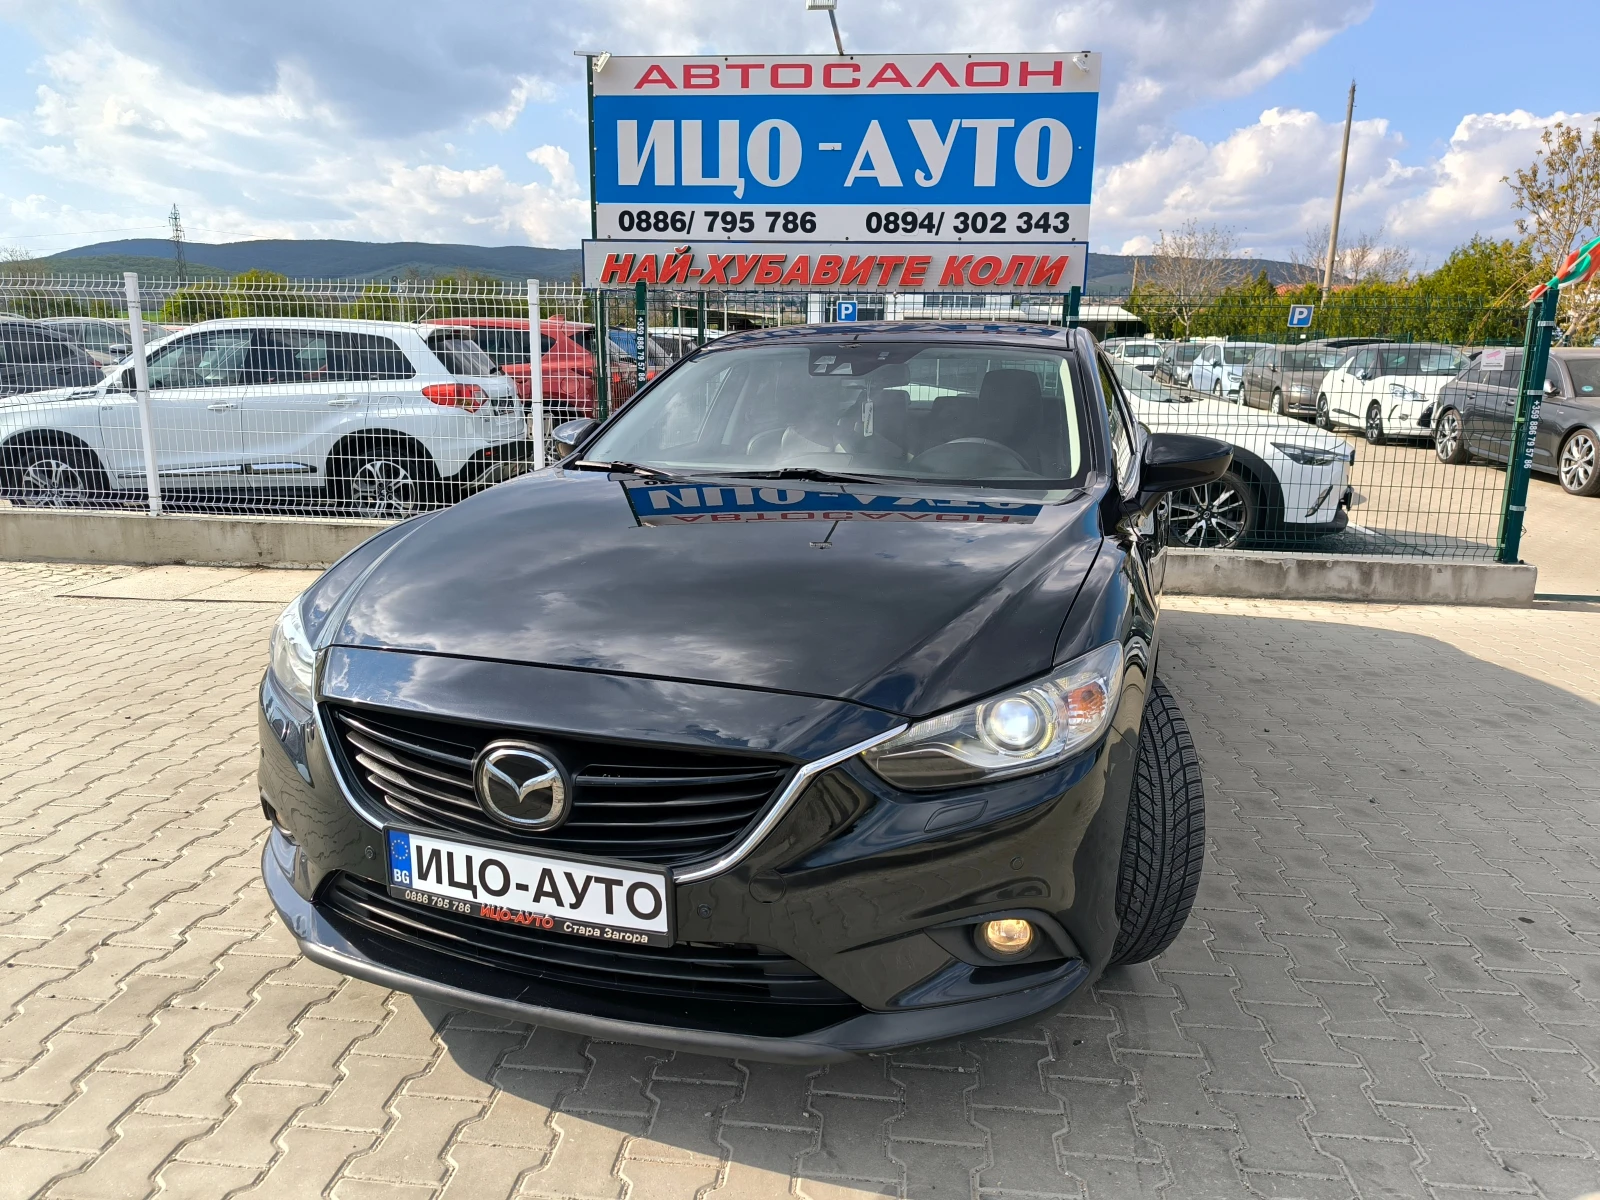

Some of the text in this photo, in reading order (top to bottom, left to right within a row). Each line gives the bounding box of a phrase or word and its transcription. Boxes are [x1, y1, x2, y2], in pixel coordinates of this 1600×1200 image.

[633, 61, 1063, 90] АВТОСАЛОН
[618, 210, 817, 234] 0886/ 795 786
[865, 211, 1070, 235] 0894/ 302 343
[599, 245, 1071, 287] НАЙ-ХУБАВИТЕ КОЛИ
[841, 303, 853, 320] P
[1292, 307, 1308, 325] P
[1531, 400, 1541, 419] +359
[1526, 436, 1536, 447] 79
[1525, 448, 1535, 458] 57
[393, 868, 410, 884] BG
[415, 844, 663, 921] ИЦО-АУТО
[405, 890, 649, 943] 0886 795 786 ИЦО-АУТО Стара Загора
